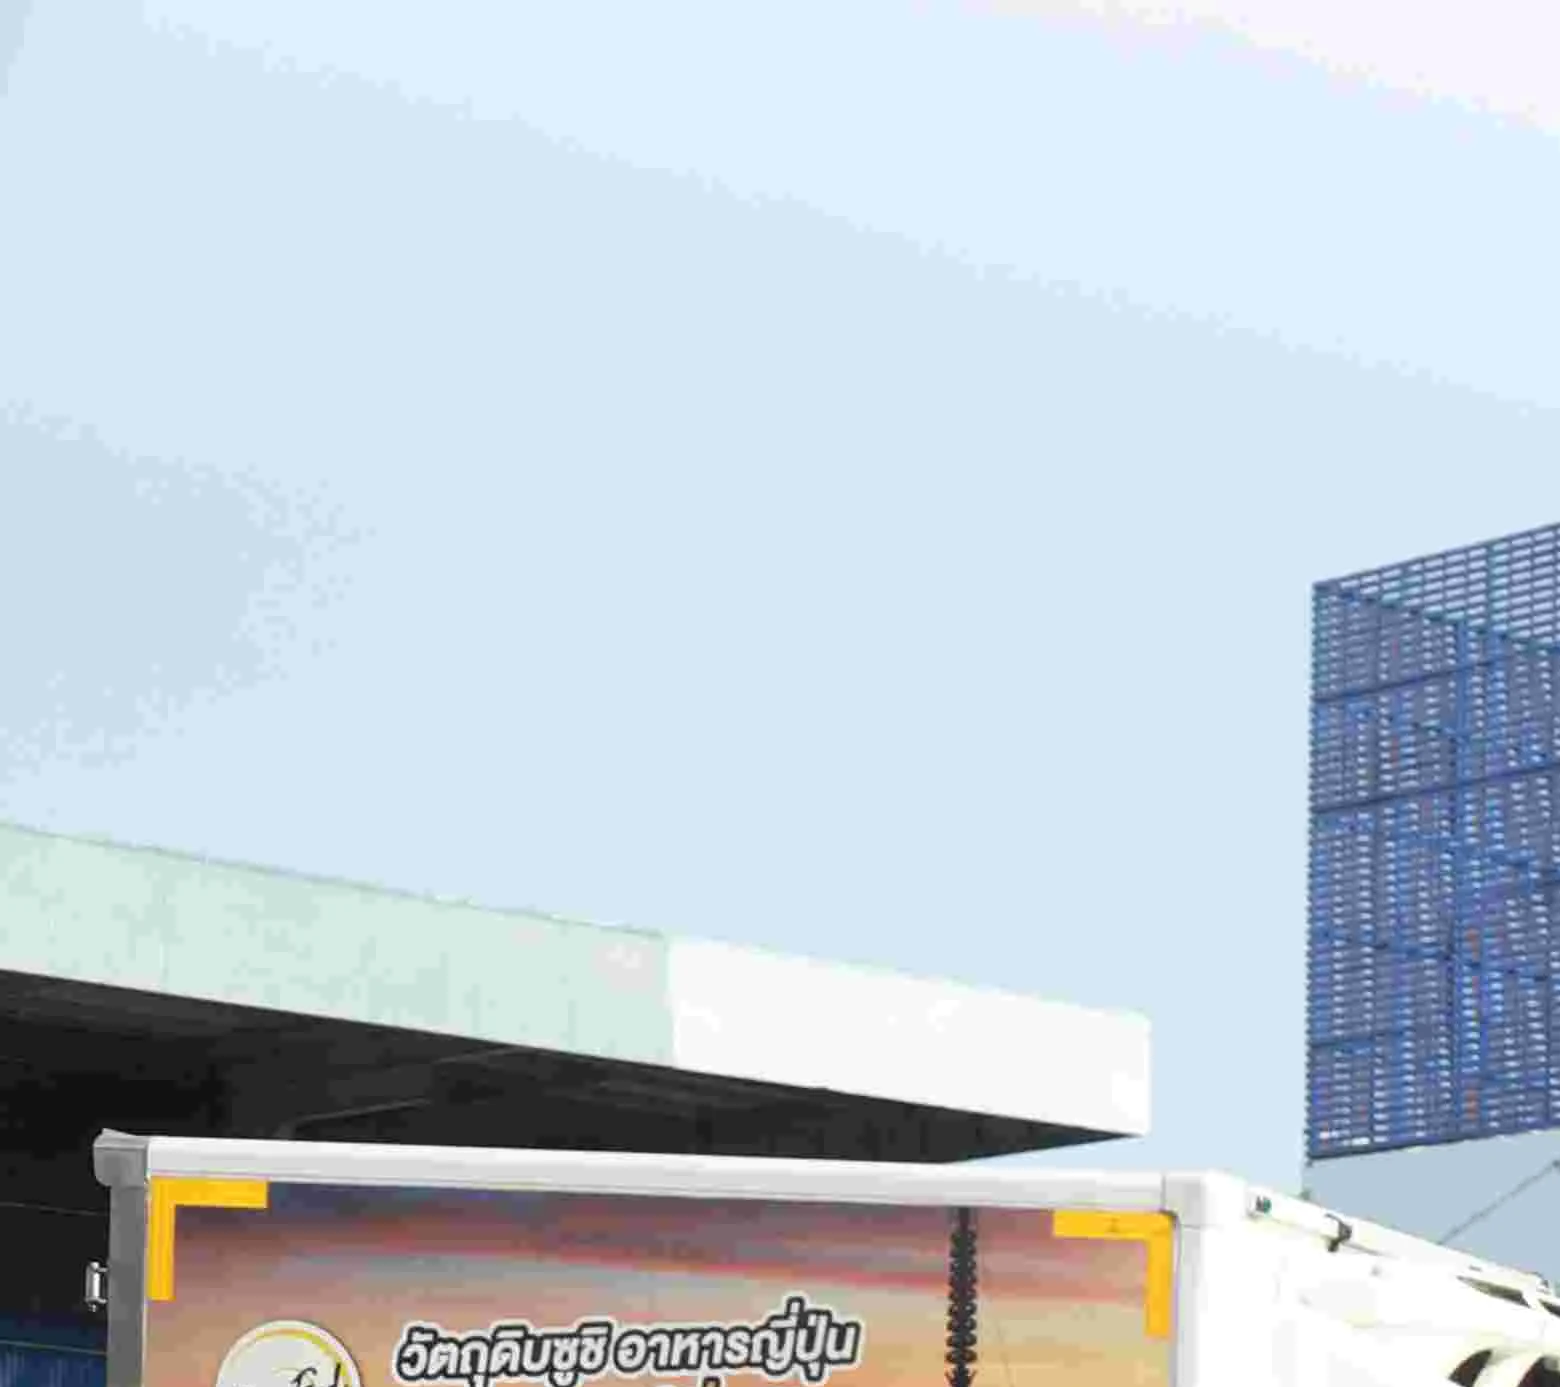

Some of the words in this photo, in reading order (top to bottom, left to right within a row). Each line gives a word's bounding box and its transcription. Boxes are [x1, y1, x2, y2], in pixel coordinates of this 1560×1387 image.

[613, 1297, 862, 1382] อาหารญี่ปุ่น
